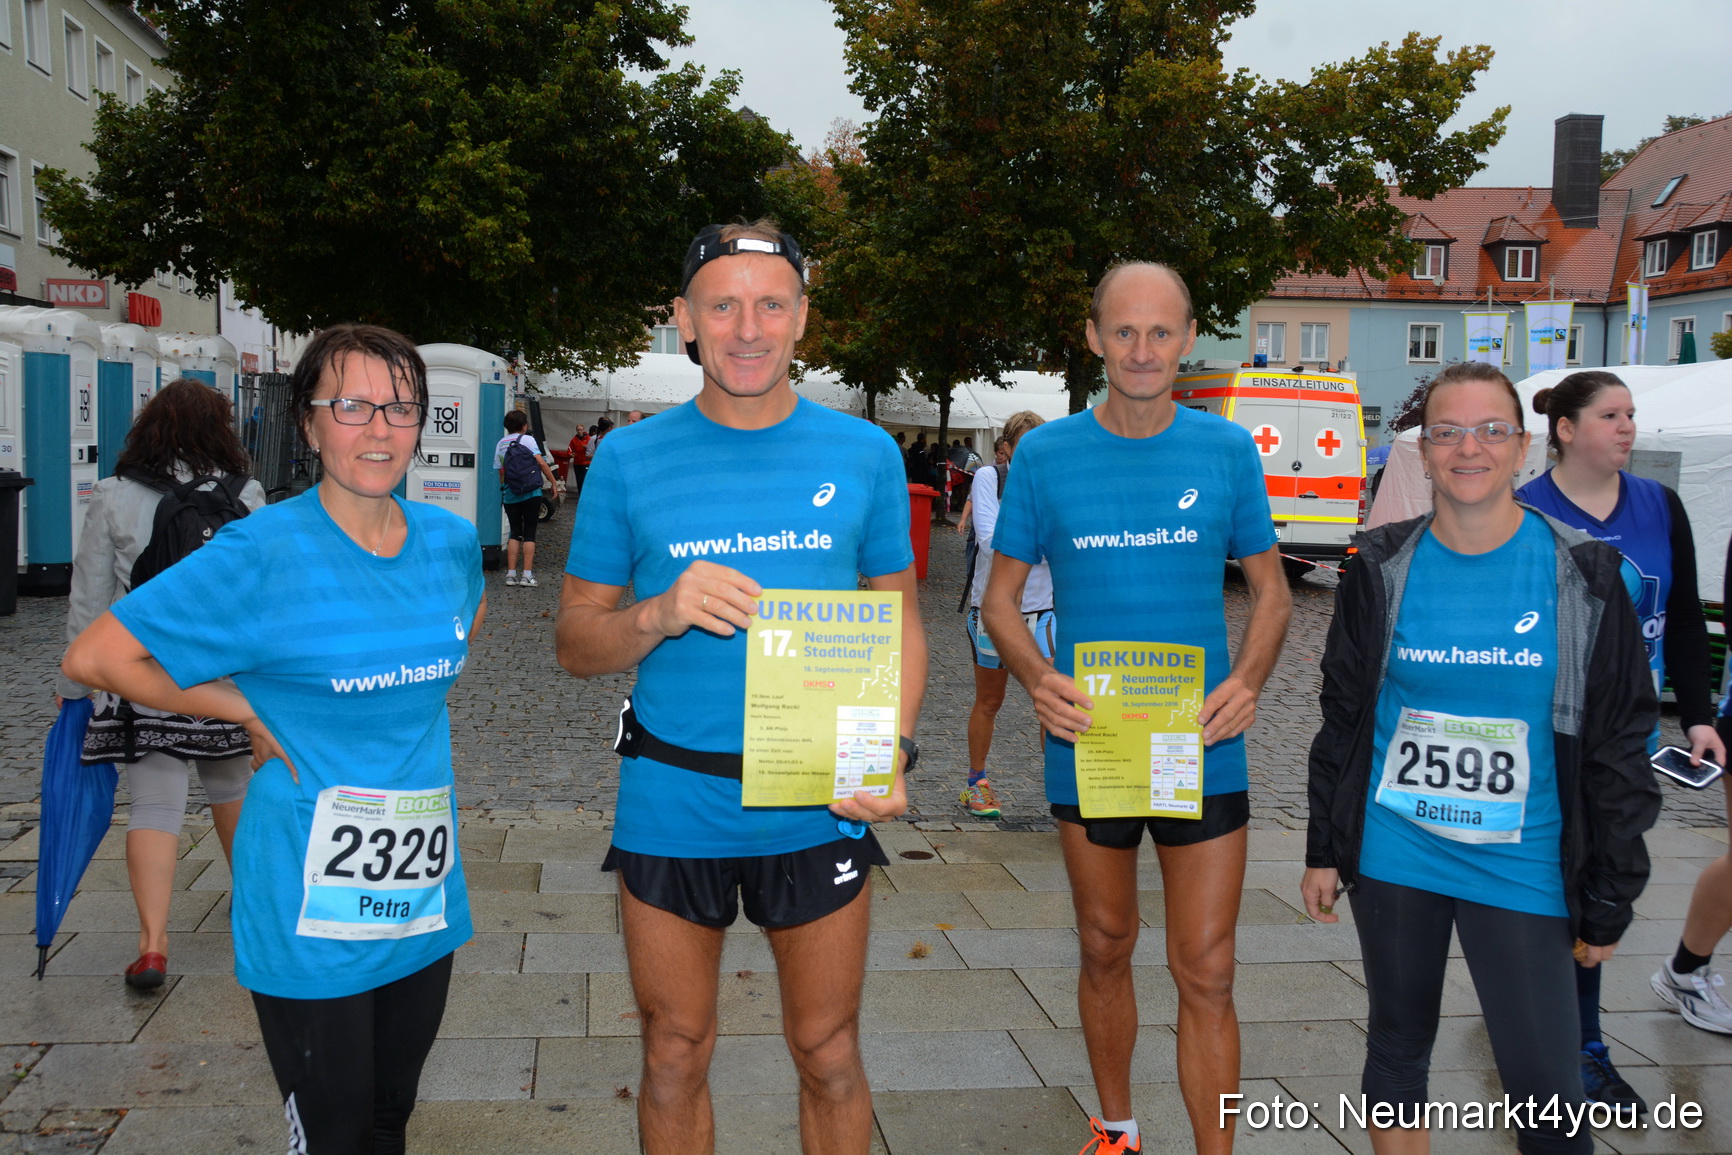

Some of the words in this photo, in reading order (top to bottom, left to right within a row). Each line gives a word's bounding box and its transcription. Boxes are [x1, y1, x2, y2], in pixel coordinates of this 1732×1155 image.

[49, 284, 103, 303] NKD
[135, 294, 162, 327] NKD
[1252, 377, 1345, 391] EINSATZLEITUNG
[80, 389, 91, 405] TOI
[80, 406, 91, 422] TOI
[434, 407, 458, 420] TOI
[434, 421, 458, 434] TOI
[669, 529, 832, 558] www.hasit.de
[1073, 526, 1198, 549] www.hasit.de
[758, 600, 893, 623] URKUNDE
[758, 629, 797, 657] 17.
[804, 632, 892, 644] Neumarkter
[804, 646, 874, 661] Stadtlauf
[1082, 651, 1197, 668] URKUNDE
[1397, 646, 1543, 667] www.hasit.de
[331, 655, 467, 692] www.hasit.d
[815, 666, 853, 674] September
[1122, 674, 1196, 683] Neumarkter
[803, 680, 828, 688] DKMS
[1084, 674, 1116, 696] 17.
[1122, 685, 1181, 696] Stadtlauf
[1444, 719, 1517, 739] BOCK
[1397, 741, 1514, 795] 2598
[332, 802, 386, 816] NeuerMarkt
[395, 793, 450, 814] BOCK
[1416, 800, 1483, 825] Bettina
[324, 824, 448, 882] 2329
[312, 873, 318, 883] C
[359, 895, 410, 918] Petra
